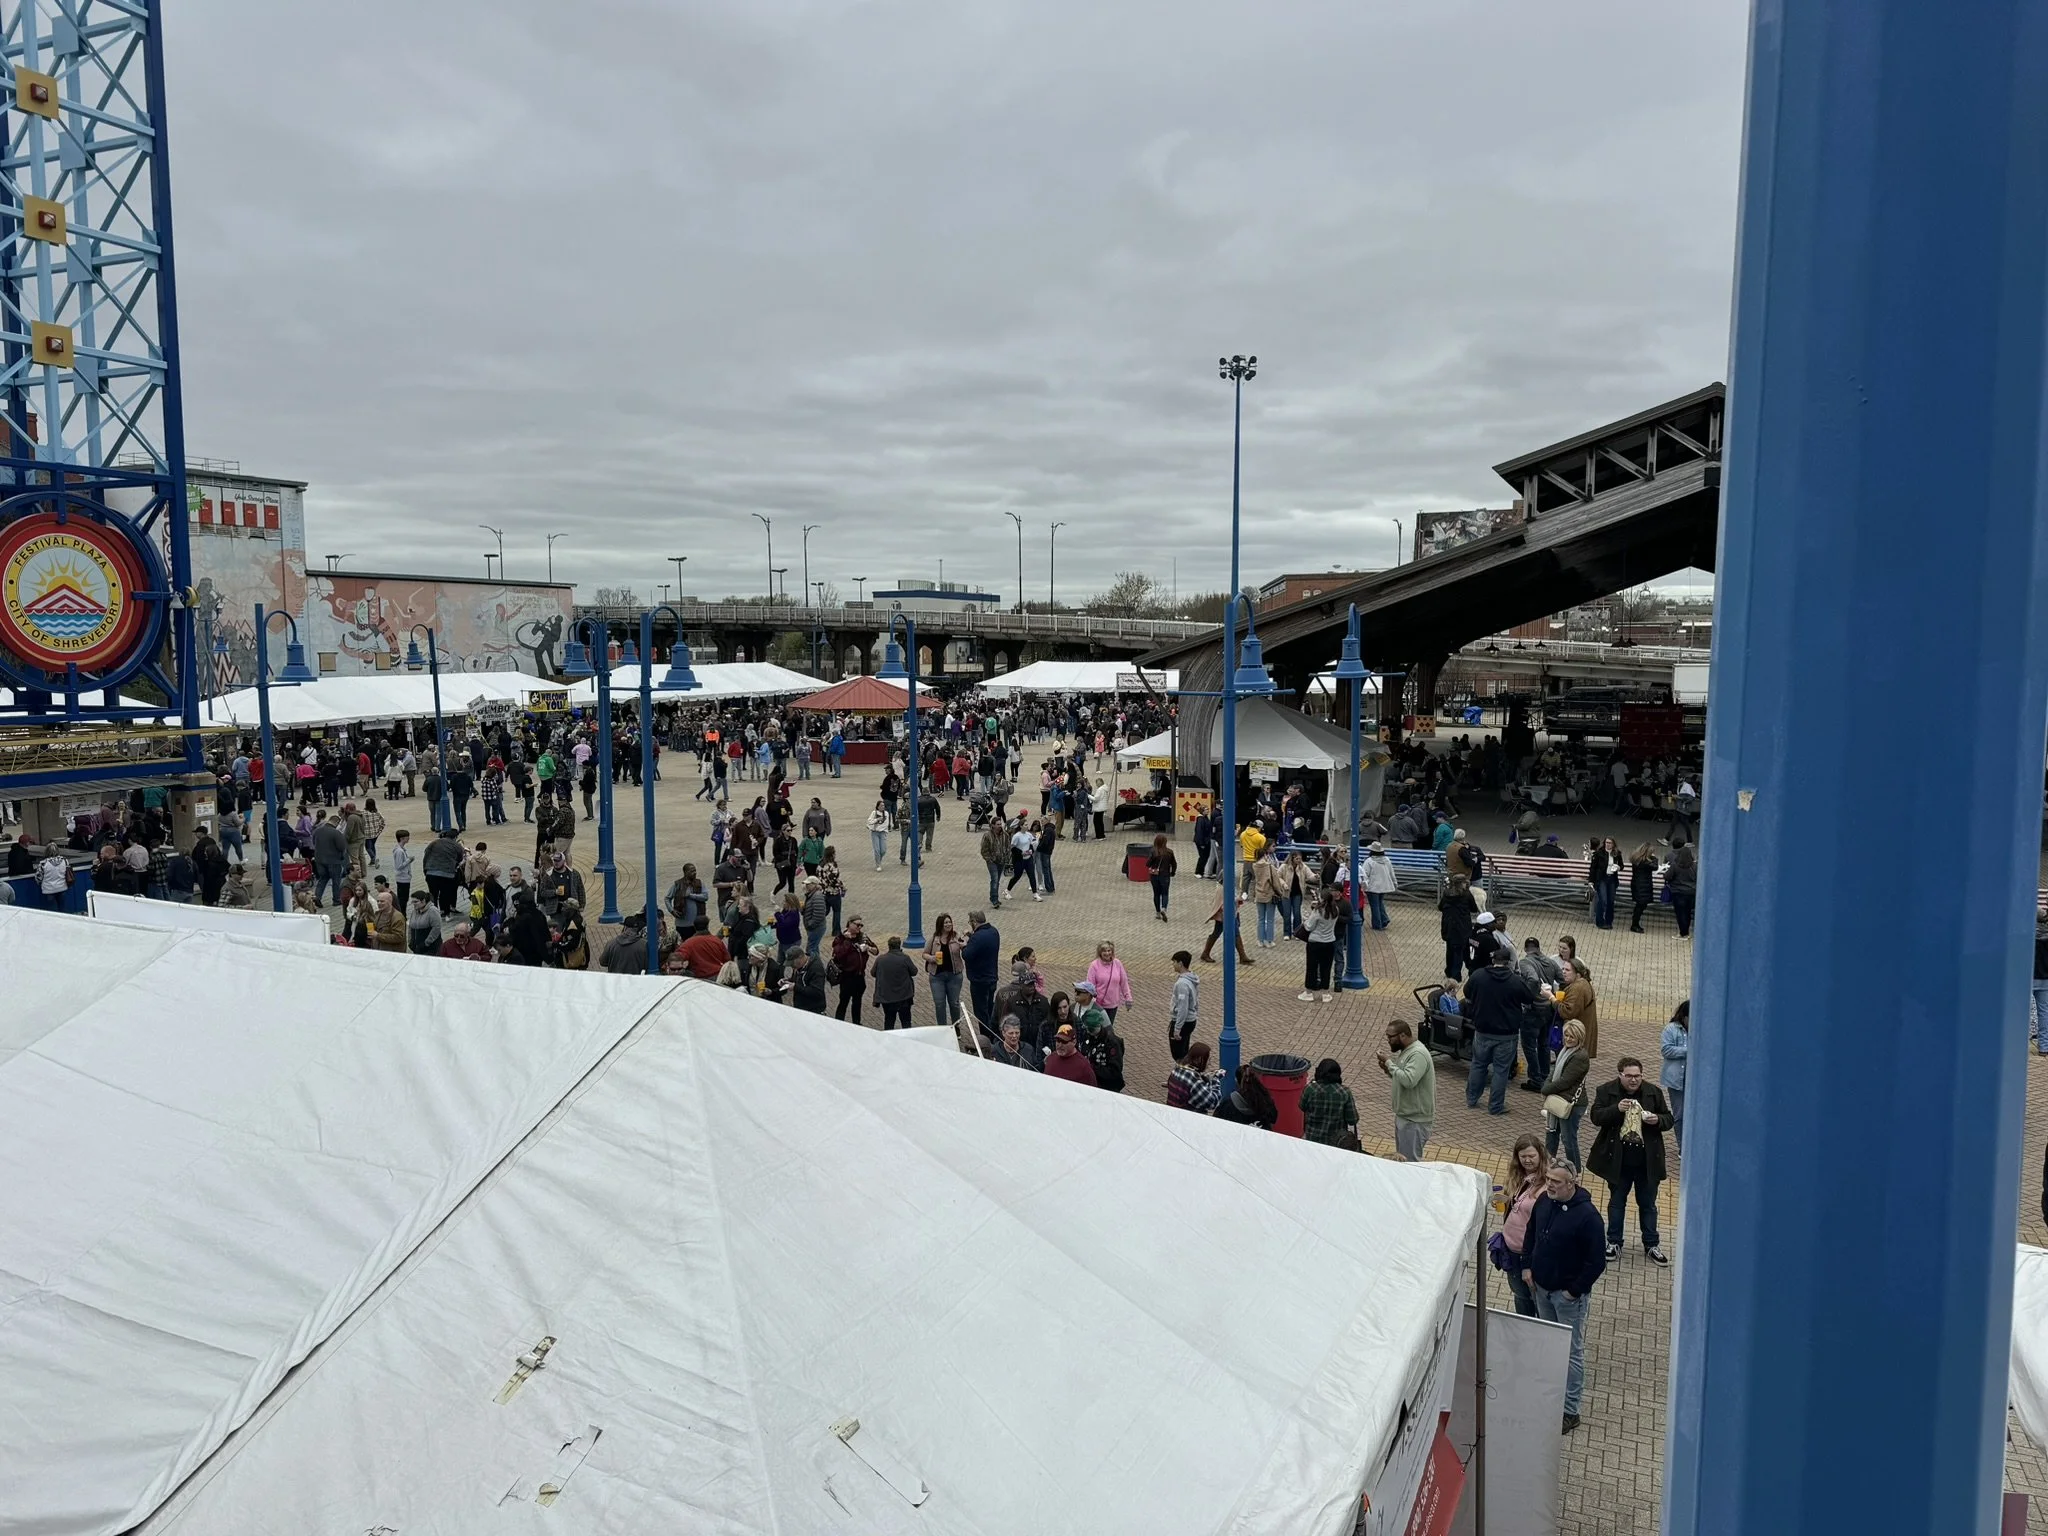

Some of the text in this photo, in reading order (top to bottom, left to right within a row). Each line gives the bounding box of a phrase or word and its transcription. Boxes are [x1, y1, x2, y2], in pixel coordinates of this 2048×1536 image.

[234, 493, 247, 501] Your
[14, 537, 107, 569] FESTIVAL PLAZA
[9, 599, 119, 648] CITY OF SHREVEPORT
[1146, 759, 1171, 767] MERCH
